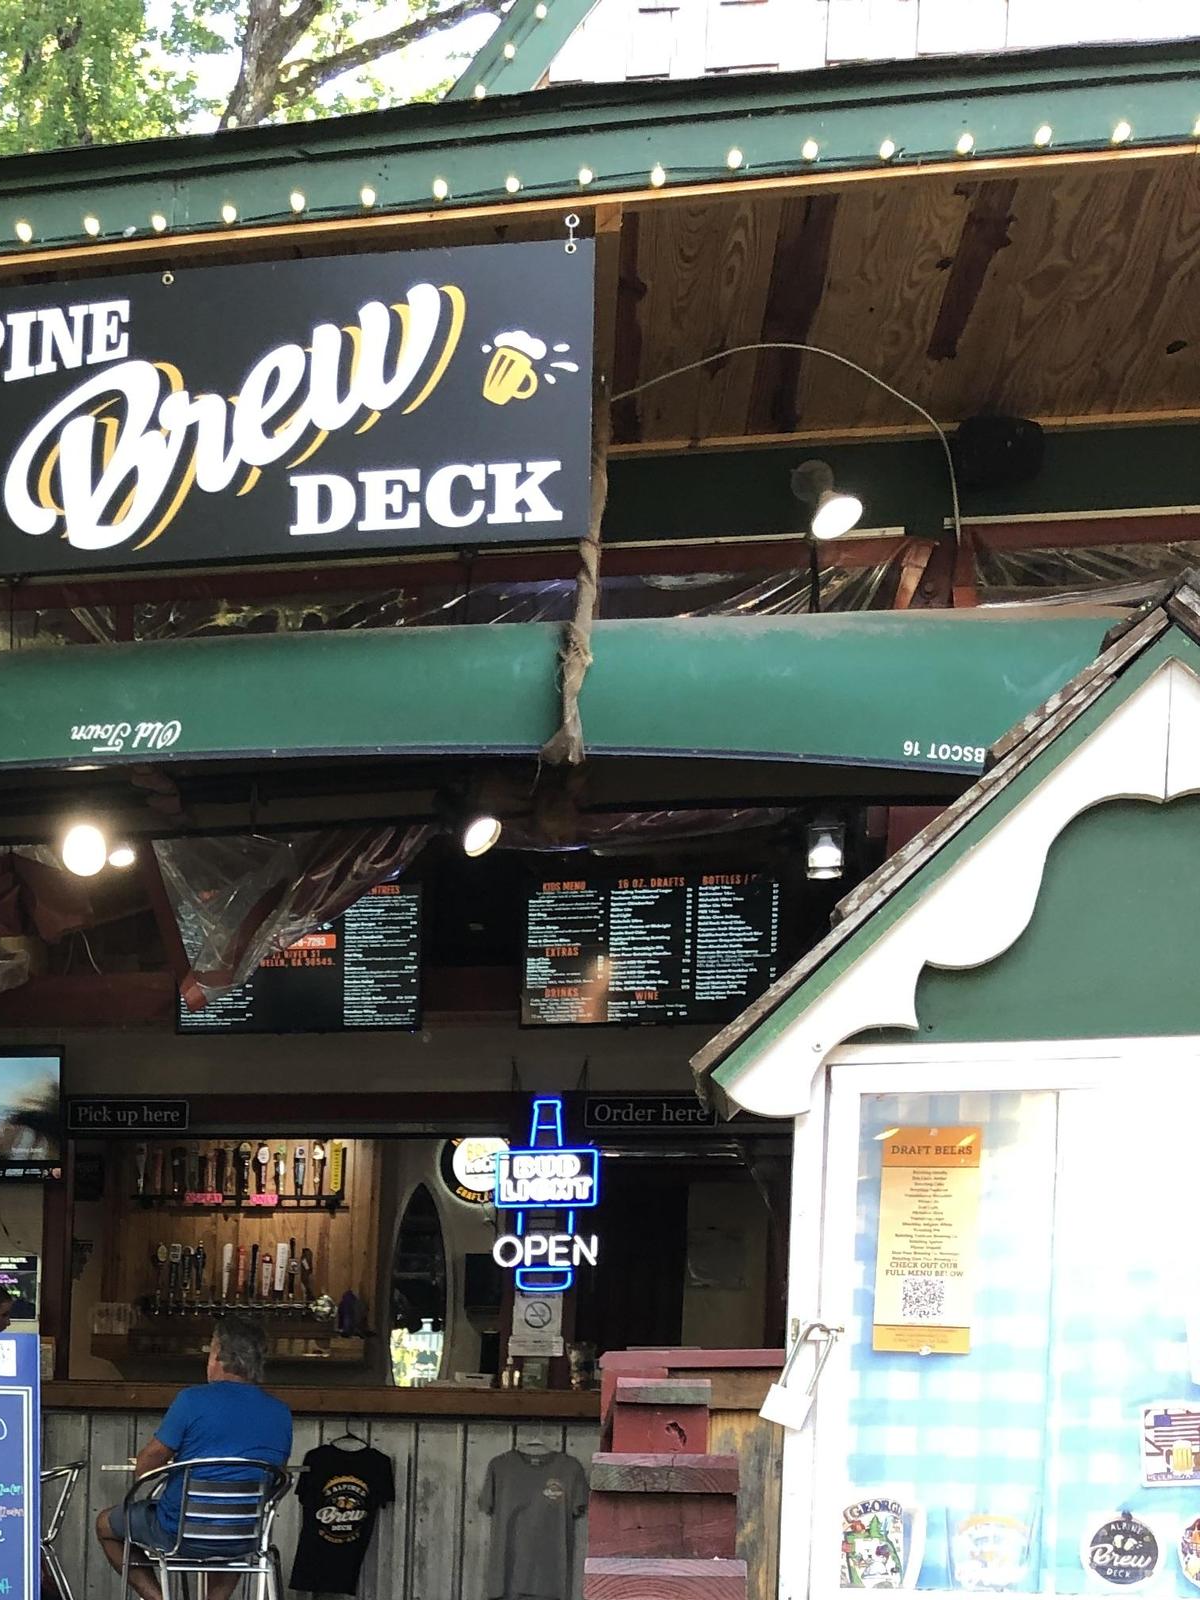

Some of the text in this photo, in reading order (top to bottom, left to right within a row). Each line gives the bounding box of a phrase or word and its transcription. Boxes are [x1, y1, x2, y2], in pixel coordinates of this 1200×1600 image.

[3, 283, 467, 551] Brew
[288, 459, 564, 537] DECK
[69, 719, 183, 753] Old Town
[903, 740, 921, 757] 16
[702, 874, 742, 886] BOTTLES
[545, 947, 579, 957] EXTRAS
[544, 988, 579, 998] DRINKS
[634, 991, 660, 1001] WINE
[76, 1104, 179, 1126] Pick up here
[594, 1102, 707, 1122] Order here
[891, 1144, 973, 1156] DRAFT BEERS
[511, 1155, 580, 1180] BUD
[498, 1176, 594, 1202] LIGHT
[493, 1234, 598, 1268] OPEN
[889, 1261, 958, 1270] CHECK OUT OUR
[907, 1269, 933, 1277] MENU
[315, 1506, 368, 1525] Brew
[1110, 1522, 1145, 1535] ALPINE
[1089, 1543, 1152, 1568] Brew
[1106, 1567, 1132, 1578] DECK
